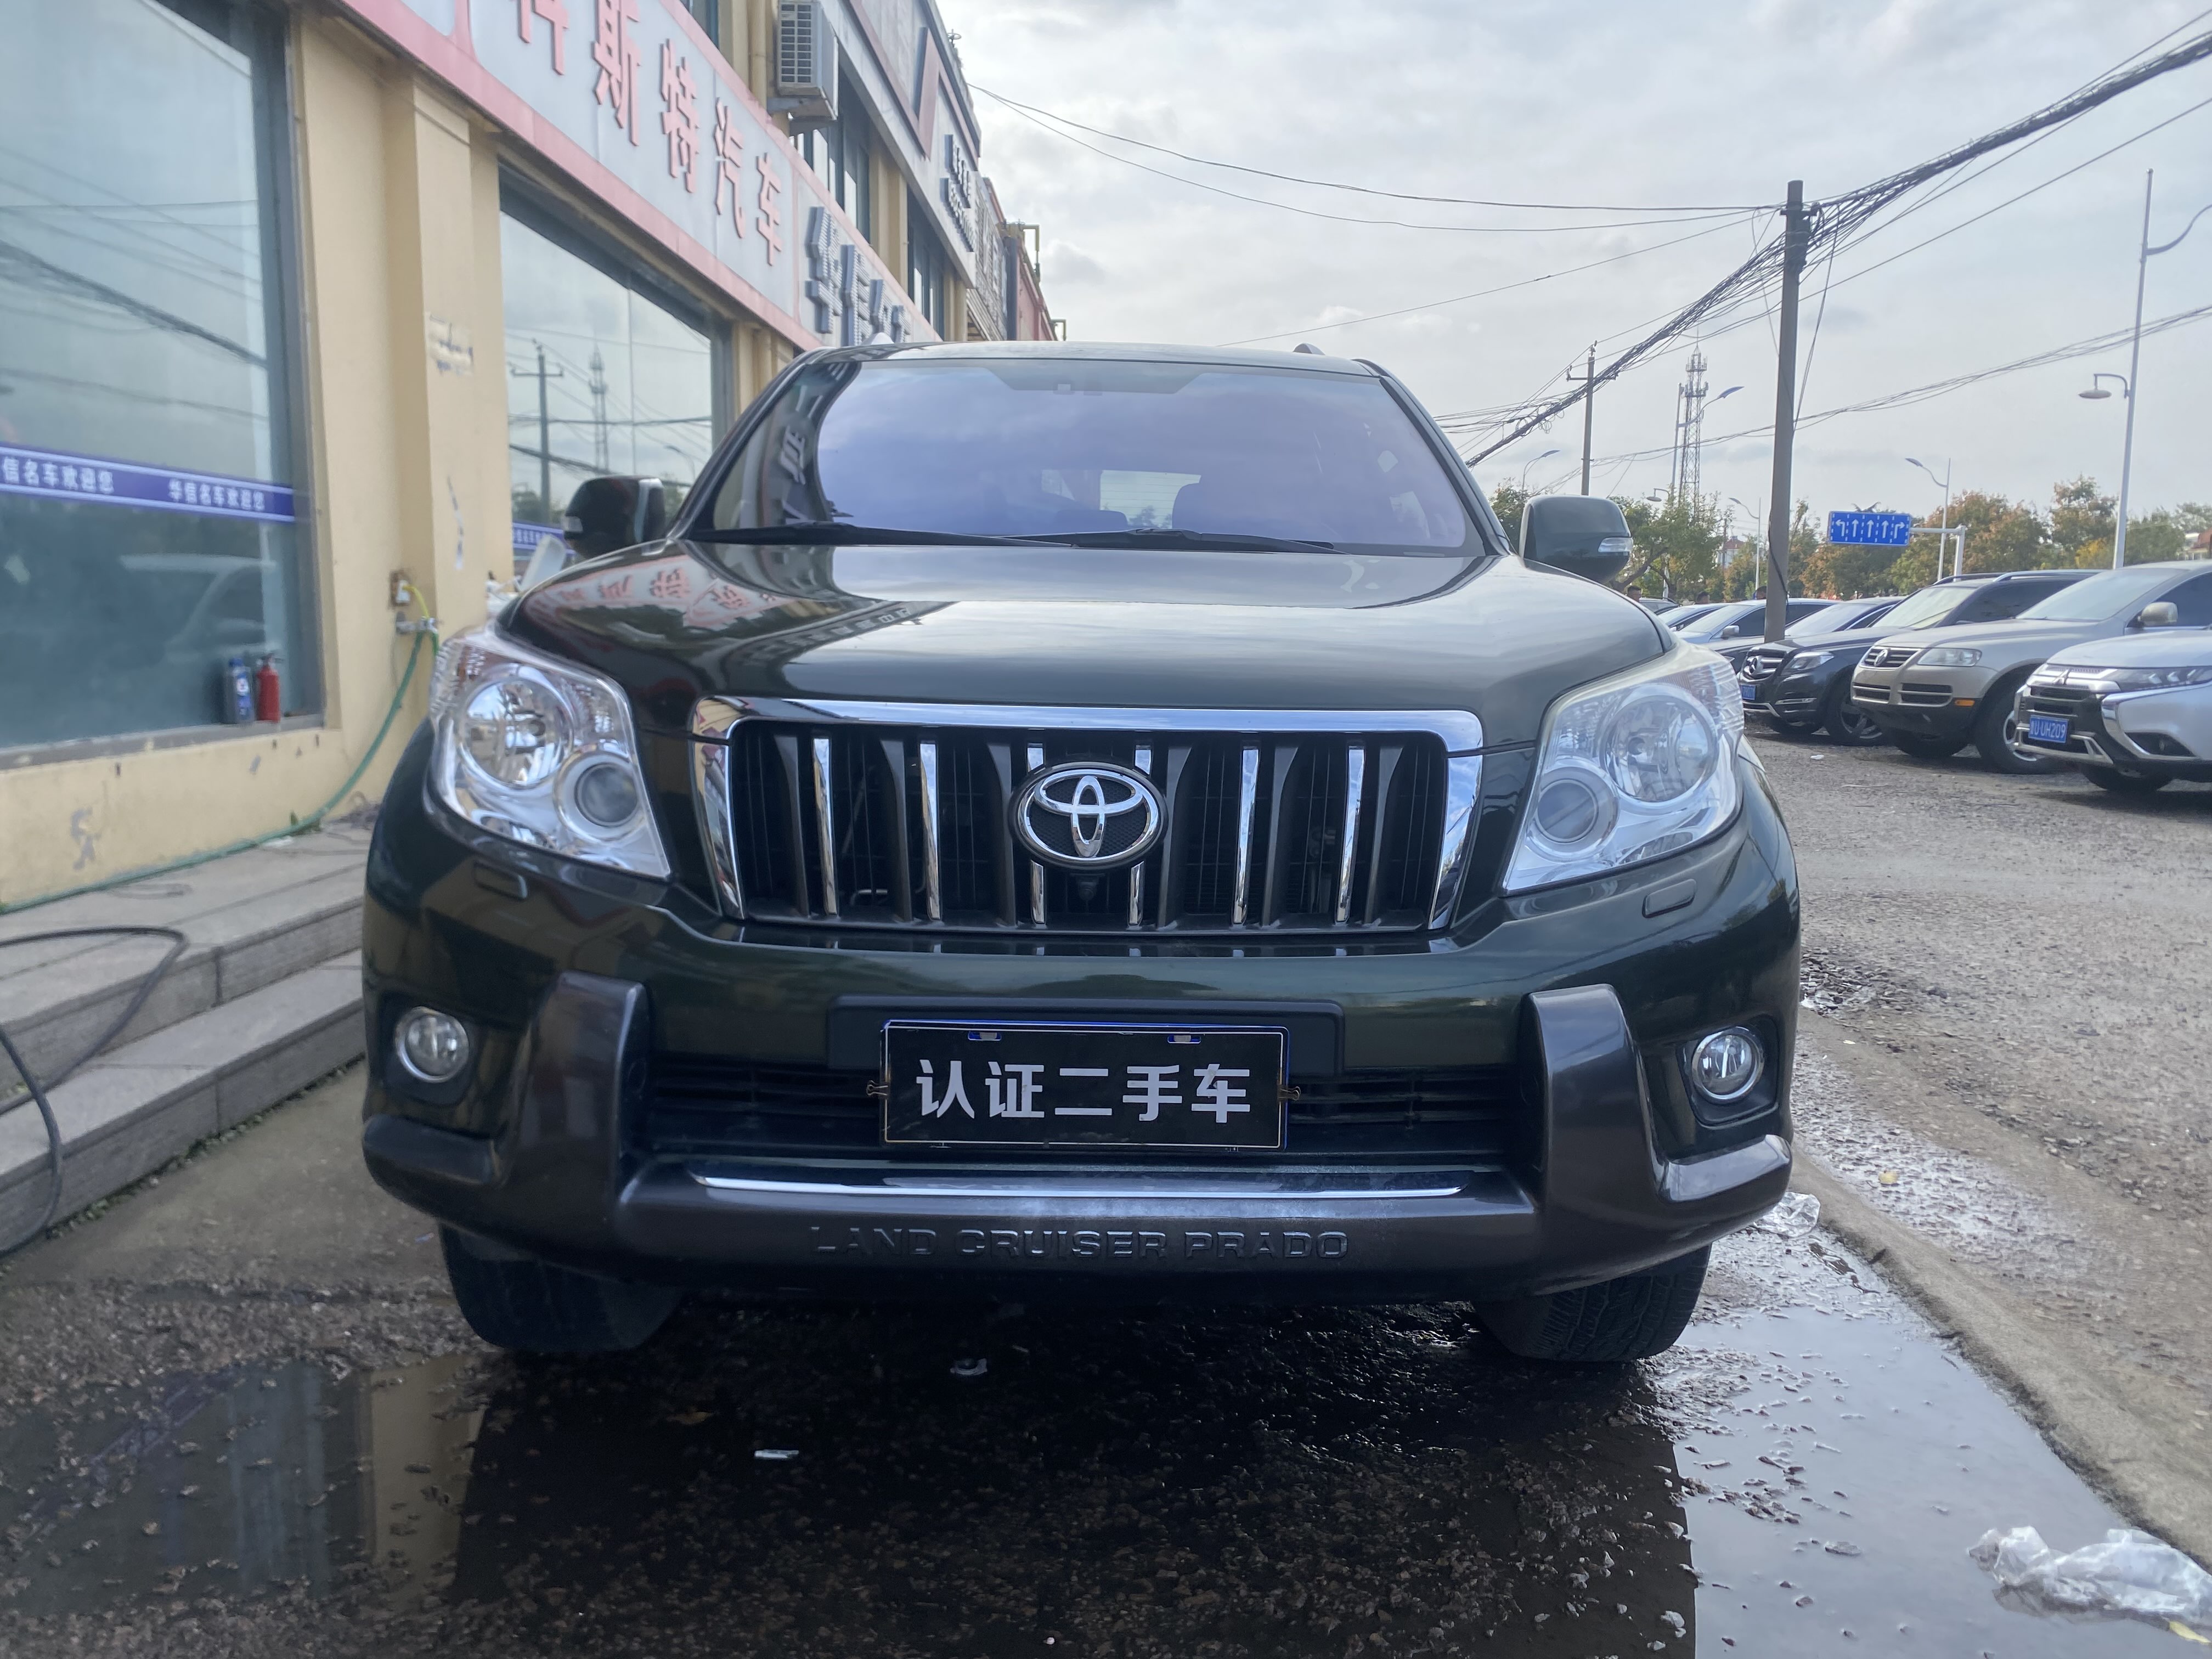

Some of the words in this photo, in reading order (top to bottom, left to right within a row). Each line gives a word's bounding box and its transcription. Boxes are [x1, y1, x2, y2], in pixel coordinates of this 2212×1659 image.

[915, 1058, 1252, 1124] 认证二手车
[810, 1226, 936, 1256] LAND
[955, 1228, 1167, 1259] CRUISER
[1183, 1231, 1349, 1260] PRADO
